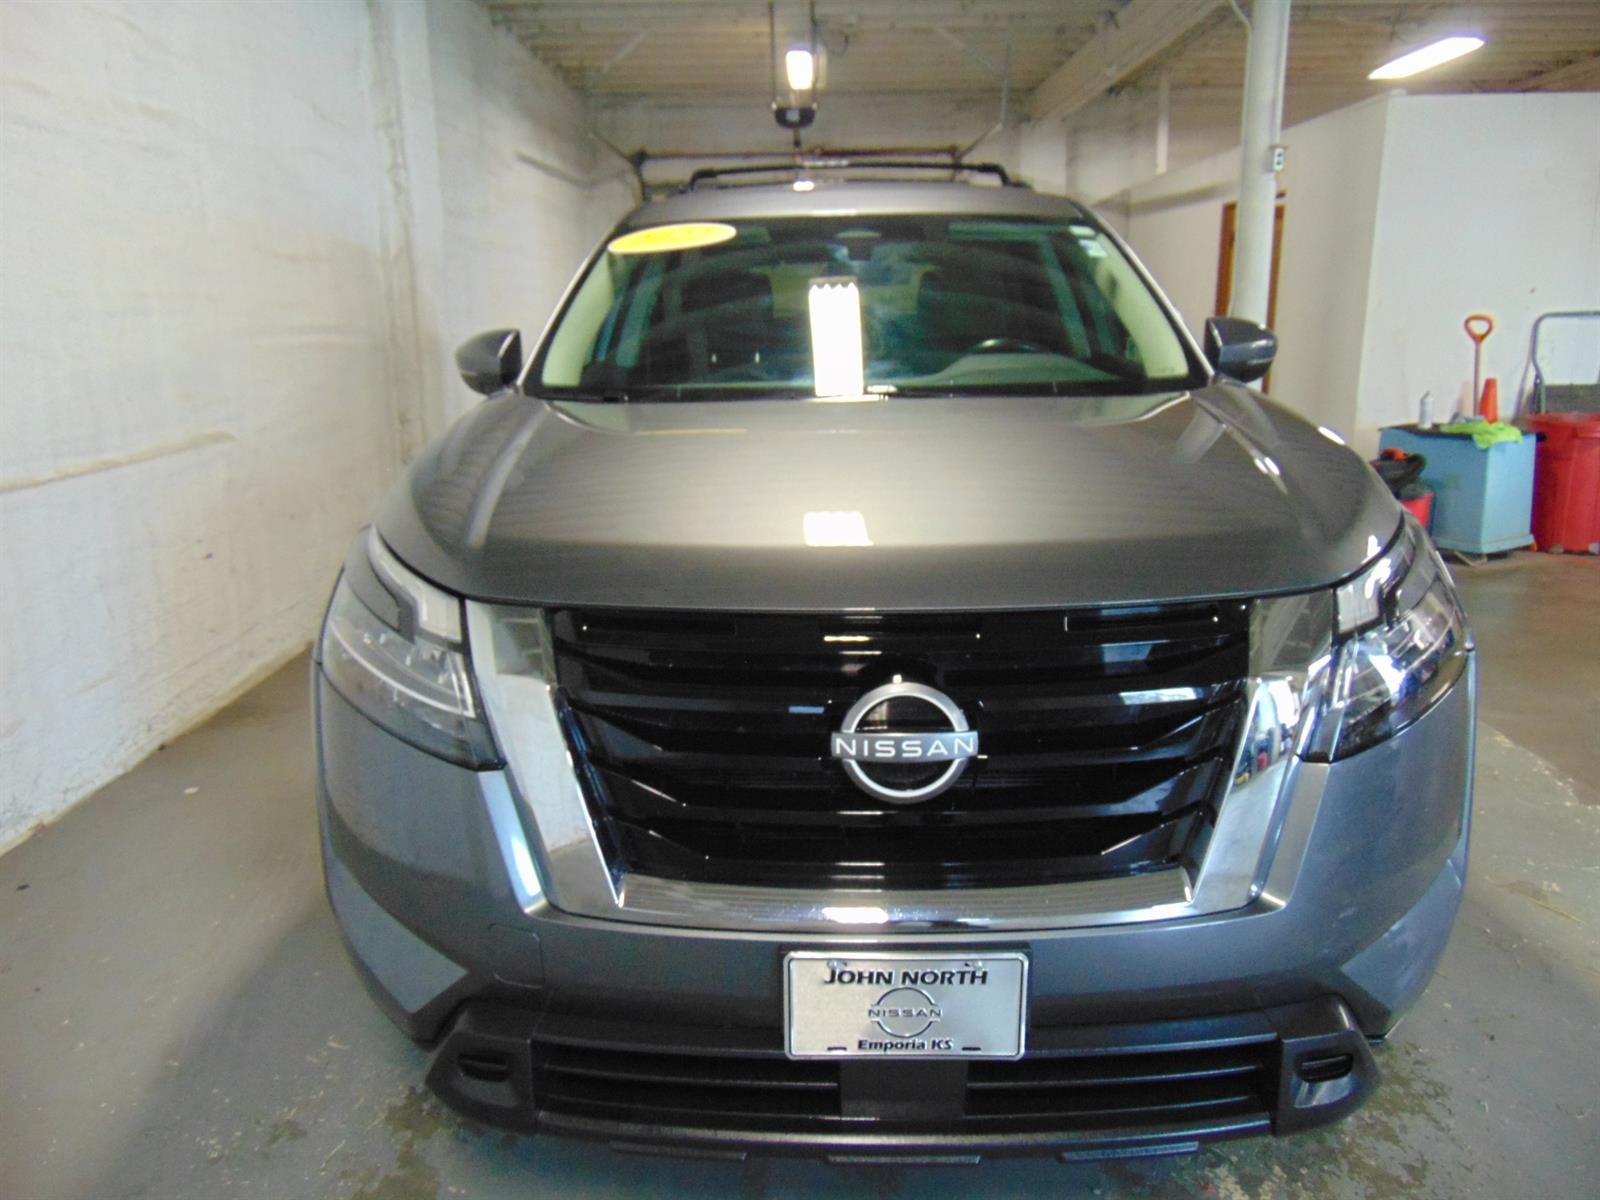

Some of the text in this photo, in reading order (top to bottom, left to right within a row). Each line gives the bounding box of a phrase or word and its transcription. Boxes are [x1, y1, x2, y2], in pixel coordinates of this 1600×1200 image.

[835, 737, 974, 757] NISSAN
[824, 968, 987, 985] JOHN NORTH
[868, 1008, 942, 1018] NISSAN
[857, 1039, 953, 1052] Emporia KS
